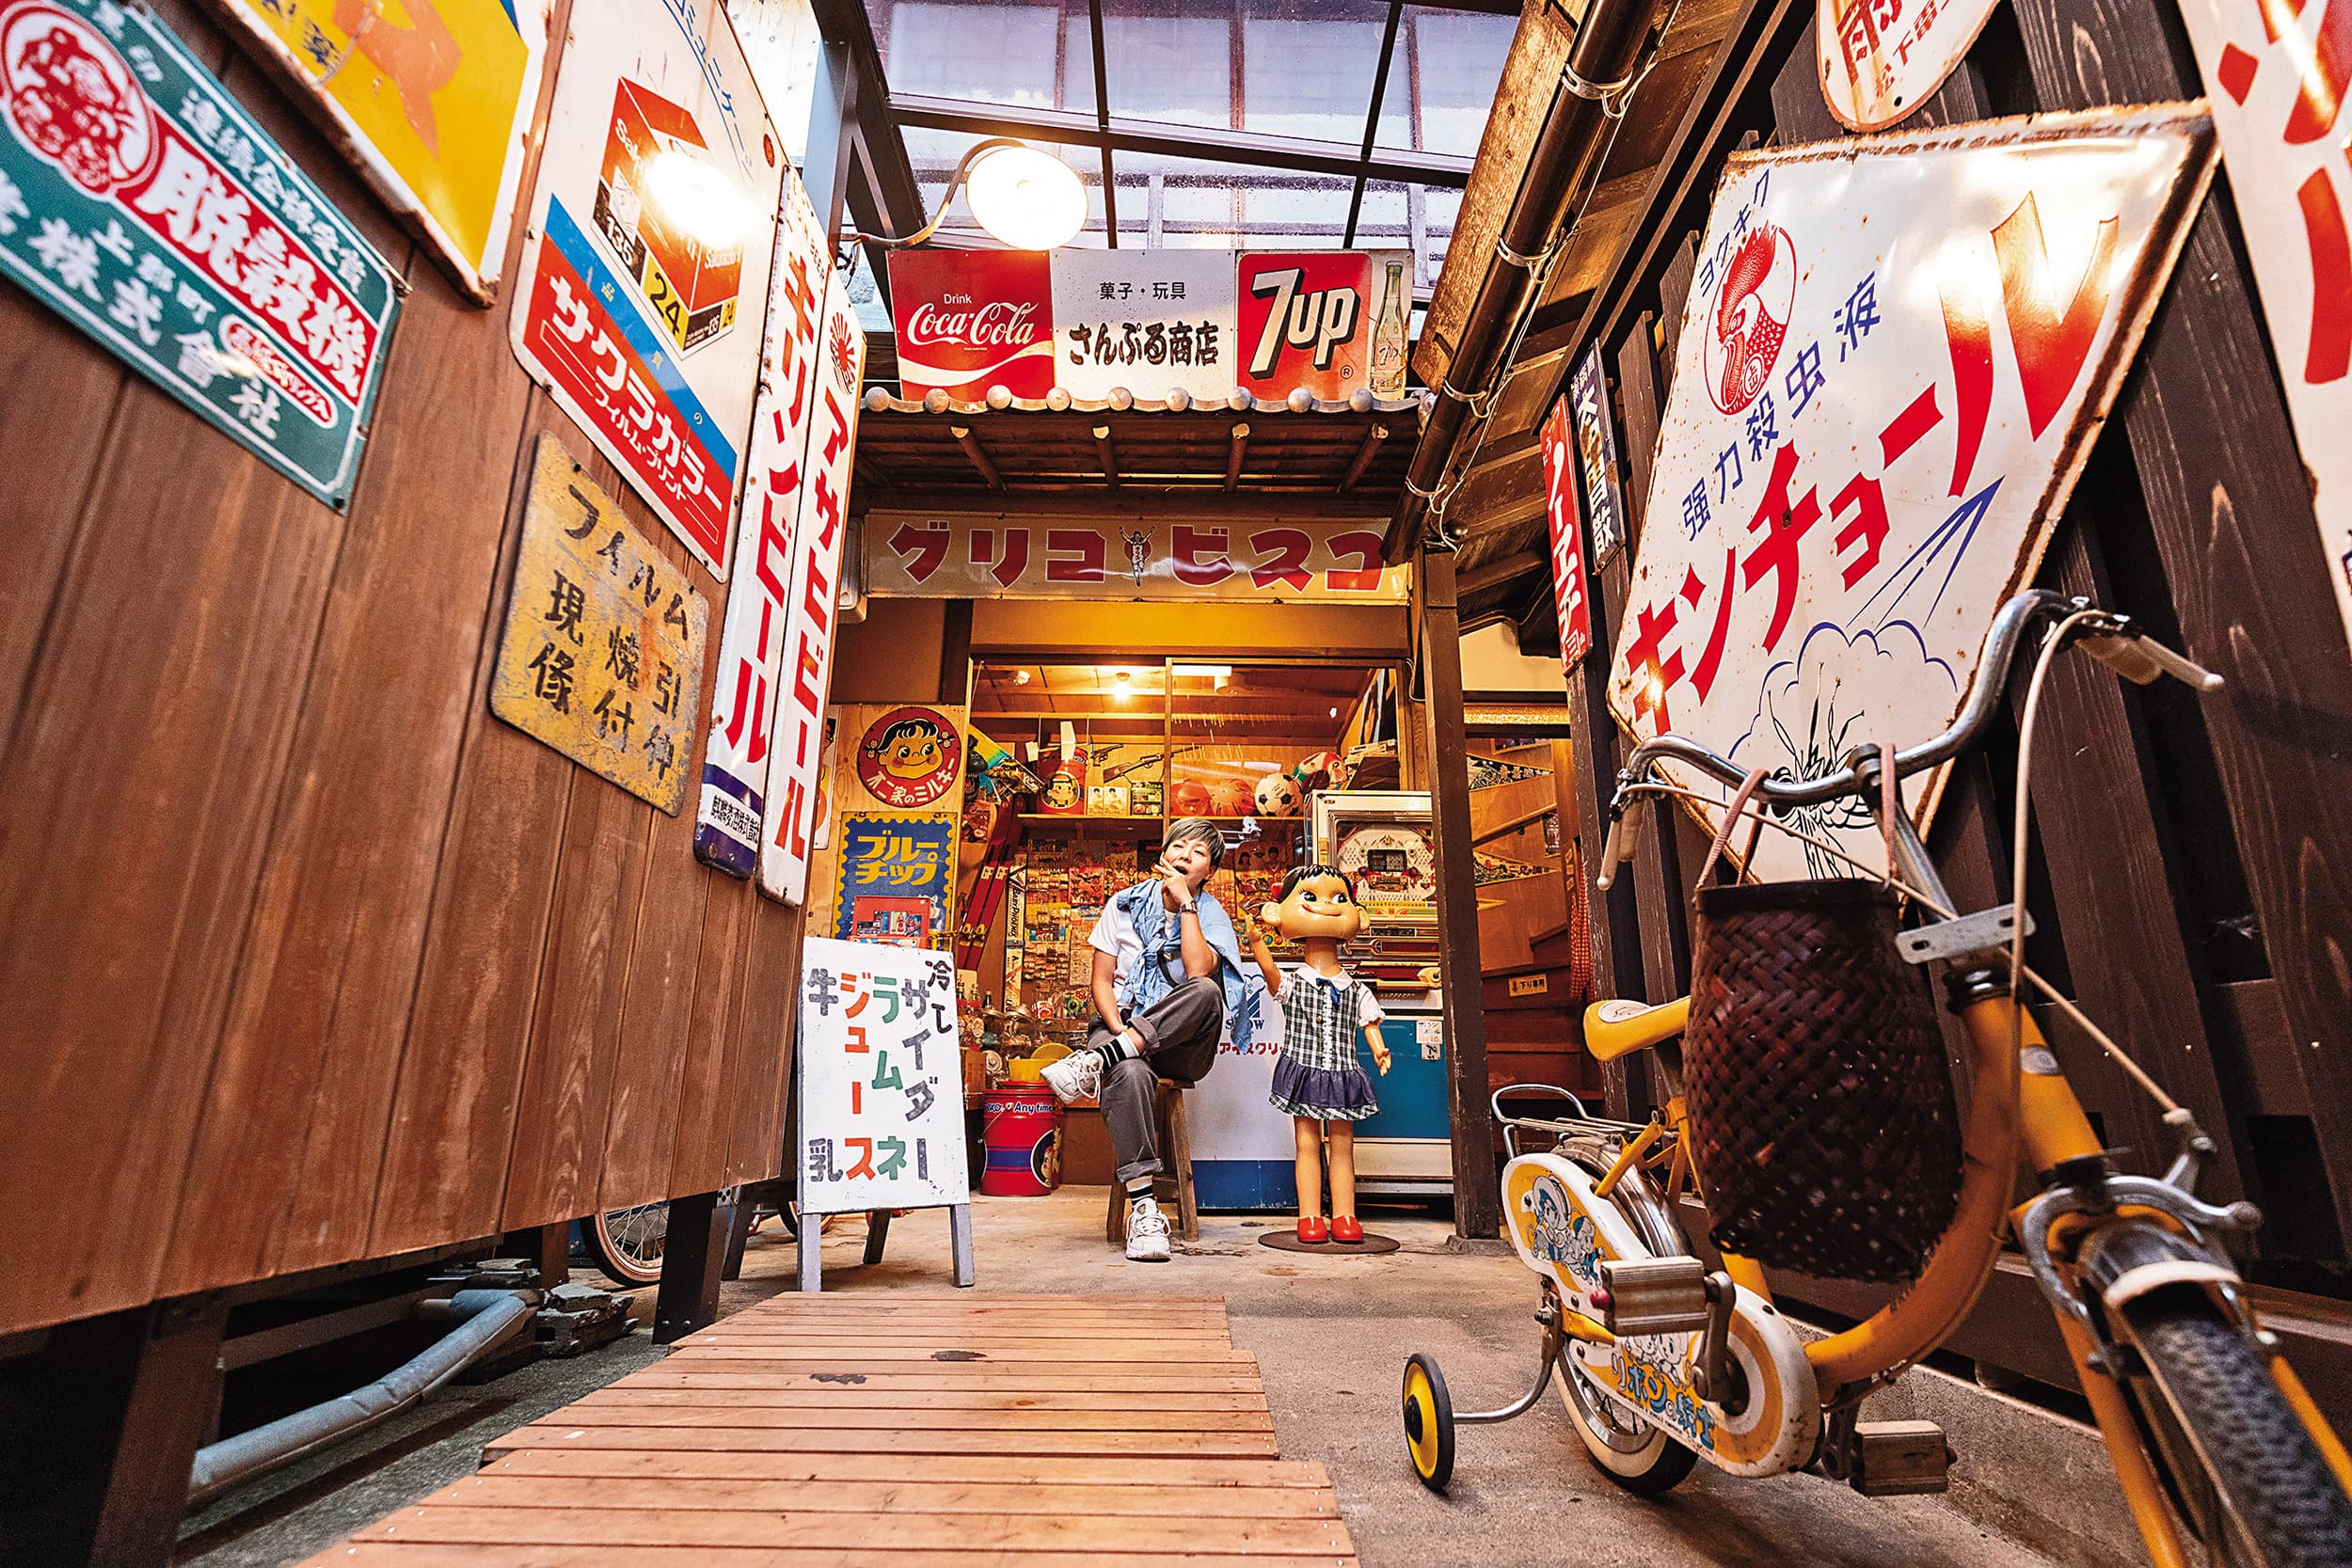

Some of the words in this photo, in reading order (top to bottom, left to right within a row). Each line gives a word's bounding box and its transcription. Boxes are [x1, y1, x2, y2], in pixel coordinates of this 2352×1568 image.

[134, 137, 368, 396] 脱穀機
[606, 214, 634, 265] 135
[1699, 169, 1772, 299] ヨクキク
[650, 271, 681, 337] 24
[907, 301, 1040, 346] Coca-Cola
[944, 293, 973, 305] Drink
[1100, 281, 1187, 301] 菓子・玩具
[1069, 321, 1219, 367] さんぷる商店
[549, 275, 723, 512] サクラカラー
[723, 249, 818, 764] キリンビール
[1625, 190, 2120, 737] キンチョール
[887, 520, 1107, 589] グリコ
[1171, 524, 1386, 593] ビスコ
[529, 569, 586, 716] 現像
[774, 386, 849, 862] アサヒビール
[643, 659, 682, 781] 引伸
[866, 757, 955, 805] 不二家のミルキー
[854, 850, 940, 886] チップ
[855, 830, 940, 863] ブルー
[925, 959, 953, 1034] 冷し
[807, 967, 844, 1182] 牛乳
[839, 971, 877, 1181] ジュース
[871, 975, 908, 1180] ラムネ
[900, 978, 938, 1180] サイダー
[1612, 1353, 1715, 1450] リボンの騎士
